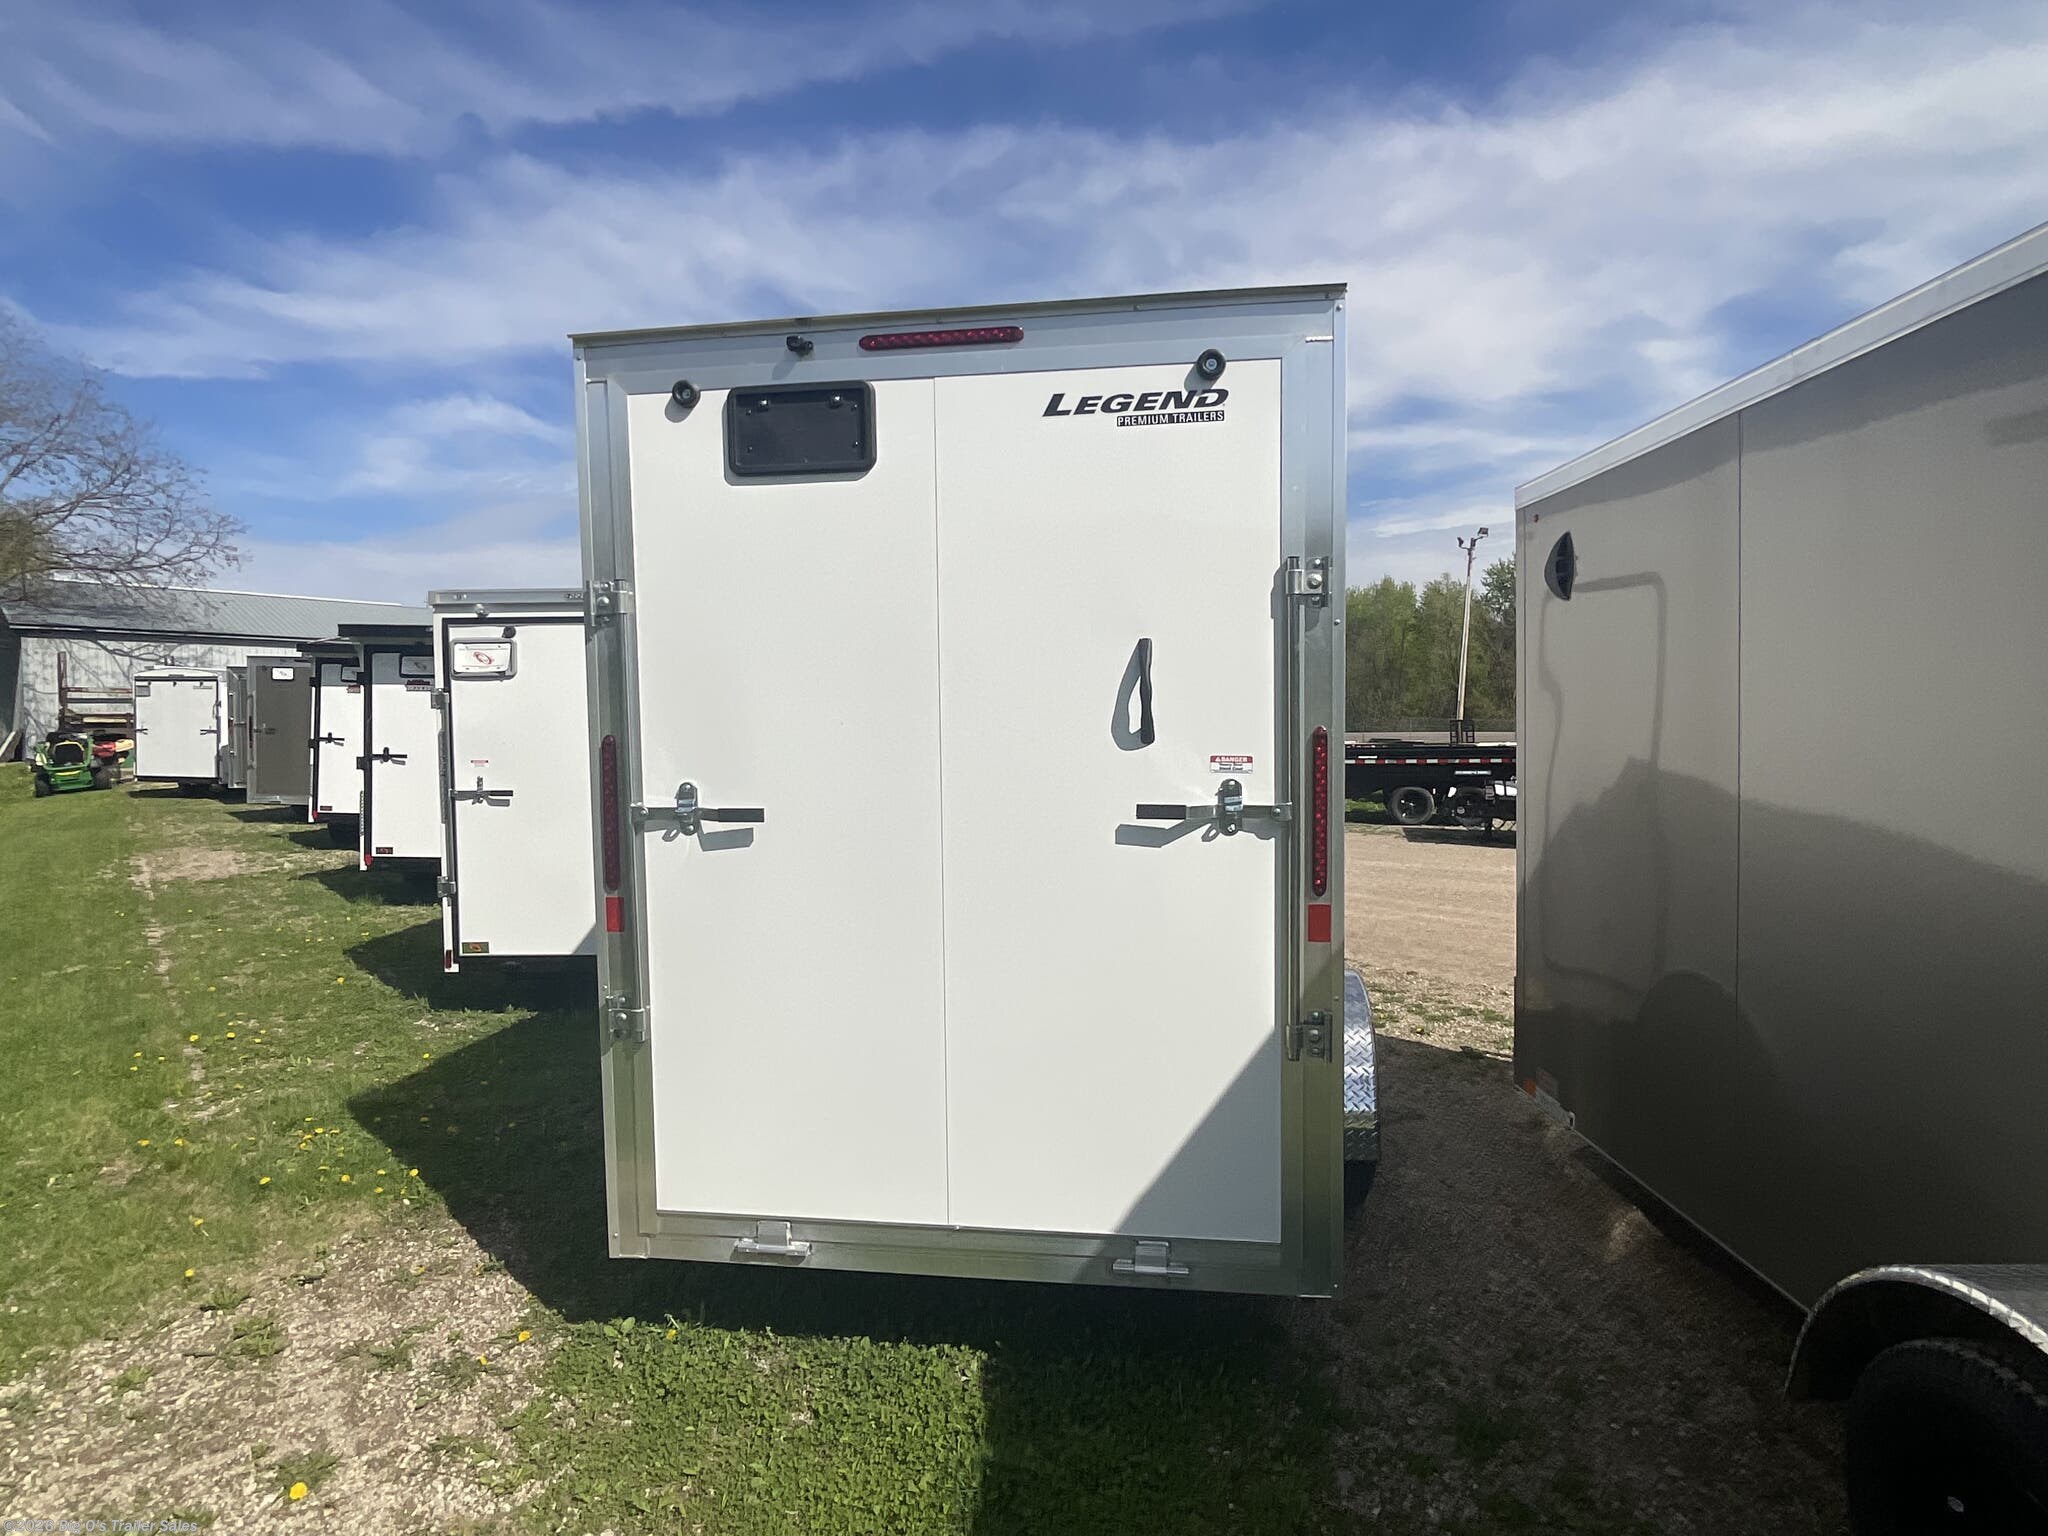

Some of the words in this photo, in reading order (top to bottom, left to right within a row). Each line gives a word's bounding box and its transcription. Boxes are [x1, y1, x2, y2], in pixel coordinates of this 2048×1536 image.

[1042, 388, 1229, 417] LEGEND
[1117, 413, 1169, 427] PREMIUM
[1173, 411, 1224, 424] TRAILERS
